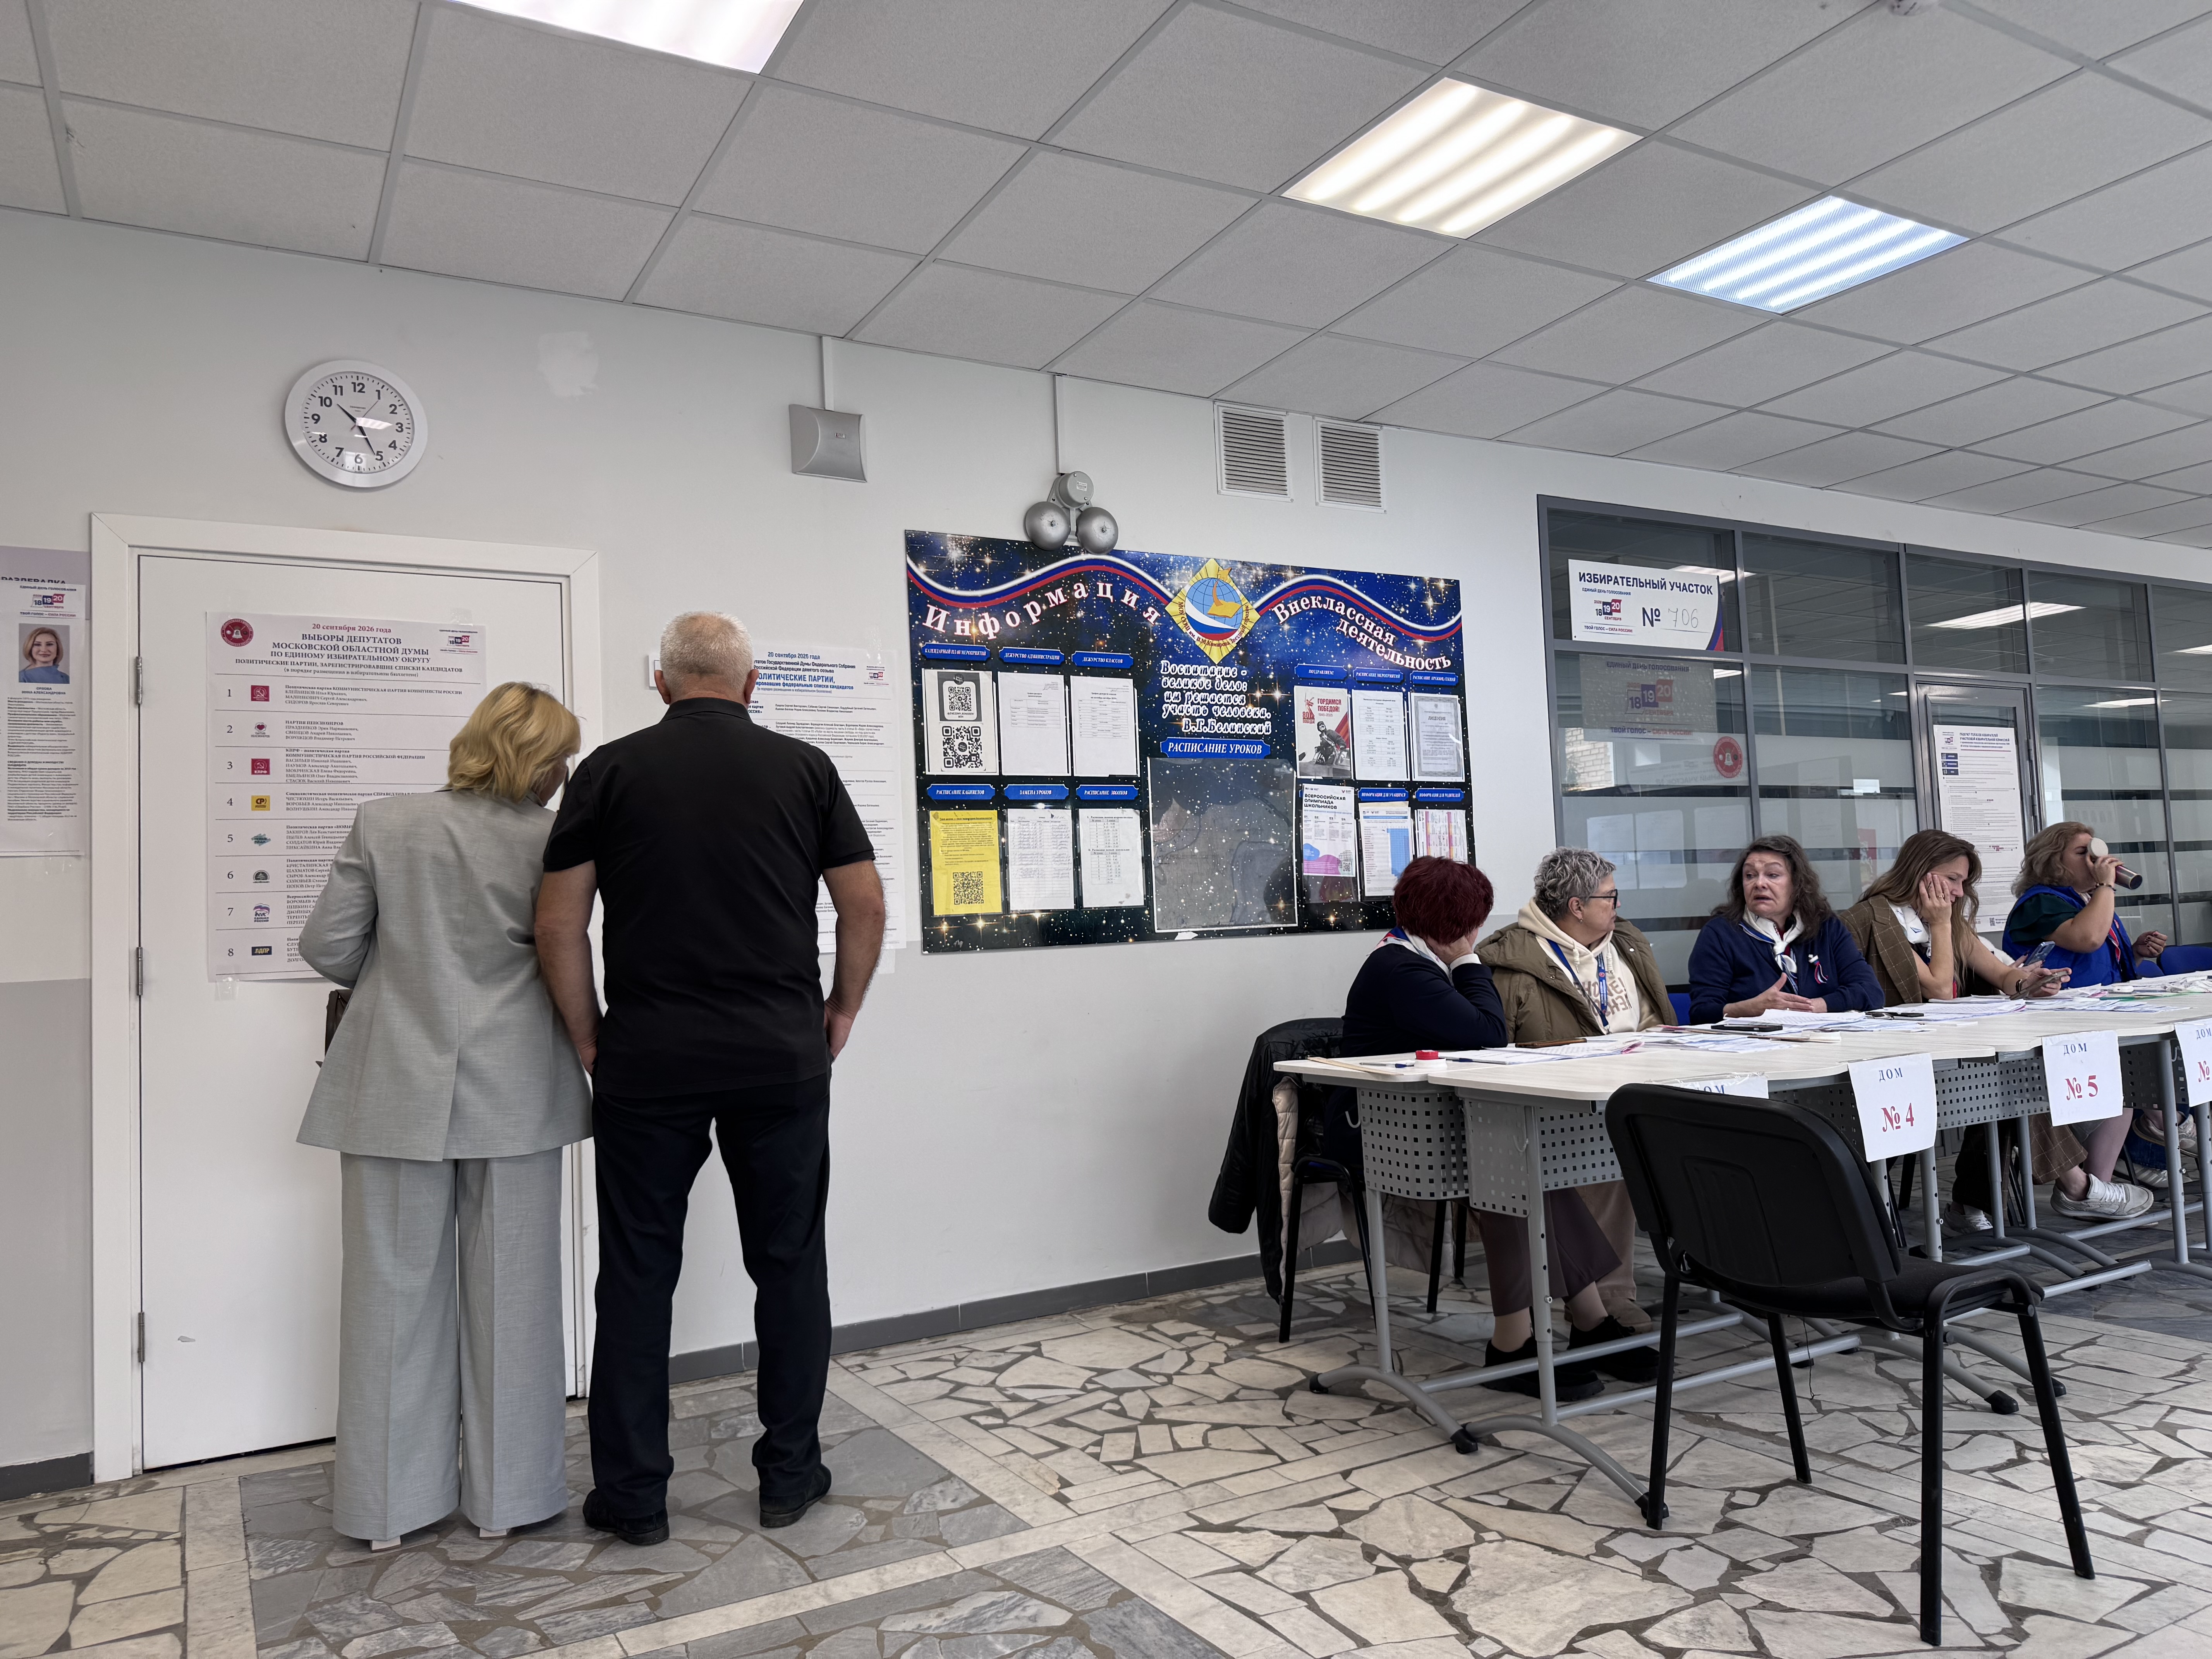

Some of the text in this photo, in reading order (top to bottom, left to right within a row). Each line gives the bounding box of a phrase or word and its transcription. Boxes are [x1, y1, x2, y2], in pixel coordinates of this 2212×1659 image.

[333, 385, 343, 396] 11
[351, 382, 366, 393] 12
[376, 390, 381, 400] 1
[318, 396, 333, 407] 10
[389, 404, 398, 414] 2
[311, 413, 321, 424] 9
[395, 422, 404, 433] 3
[319, 433, 327, 443] 8
[388, 440, 397, 450] 4
[335, 447, 344, 457] 7
[375, 451, 383, 461] 5
[354, 454, 363, 464] 6
[1578, 572, 1713, 595] ИЗБИРАТЕЛЬНЫЙ УЧАСТОК
[922, 581, 1162, 641] Информация
[1271, 595, 1396, 646] Внеклассная
[1642, 607, 1661, 627] №
[1668, 608, 1698, 628] 706
[302, 634, 402, 645] ВЫБОРЫ ДЕПУТАТОВ
[1336, 618, 1451, 672] деятельность
[272, 642, 339, 651] МОСКОВСКОЙ
[342, 645, 398, 654] ОБЛАСТНОЙ
[327, 654, 400, 662] ИЗБИРАТЕЛЬНОМУ
[320, 662, 393, 670] ЗАРЕГИСТРИРОВАВШИЕ
[1161, 660, 1237, 677] Воспитание
[1648, 664, 1689, 672] ГОЛОСОВАНИЯ
[809, 675, 835, 684] ПАРТИИ,
[1162, 677, 1247, 692] великое дело:
[1164, 691, 1246, 705] им решается
[1630, 685, 1671, 709] 18 19 20
[1162, 704, 1271, 719] участь человека.
[1182, 718, 1271, 735] В.Г.Белинский
[1168, 742, 1262, 754] РАСПИСАНИЕ УРОКОВ
[228, 908, 234, 916] 7
[2063, 1042, 2087, 1056] ДОМ
[1879, 1067, 1903, 1082] ДОМ
[2197, 1061, 2210, 1083] №
[1695, 1085, 1725, 1094] ОМ
[2065, 1075, 2098, 1101] № 5
[1881, 1103, 1914, 1132] № 4
